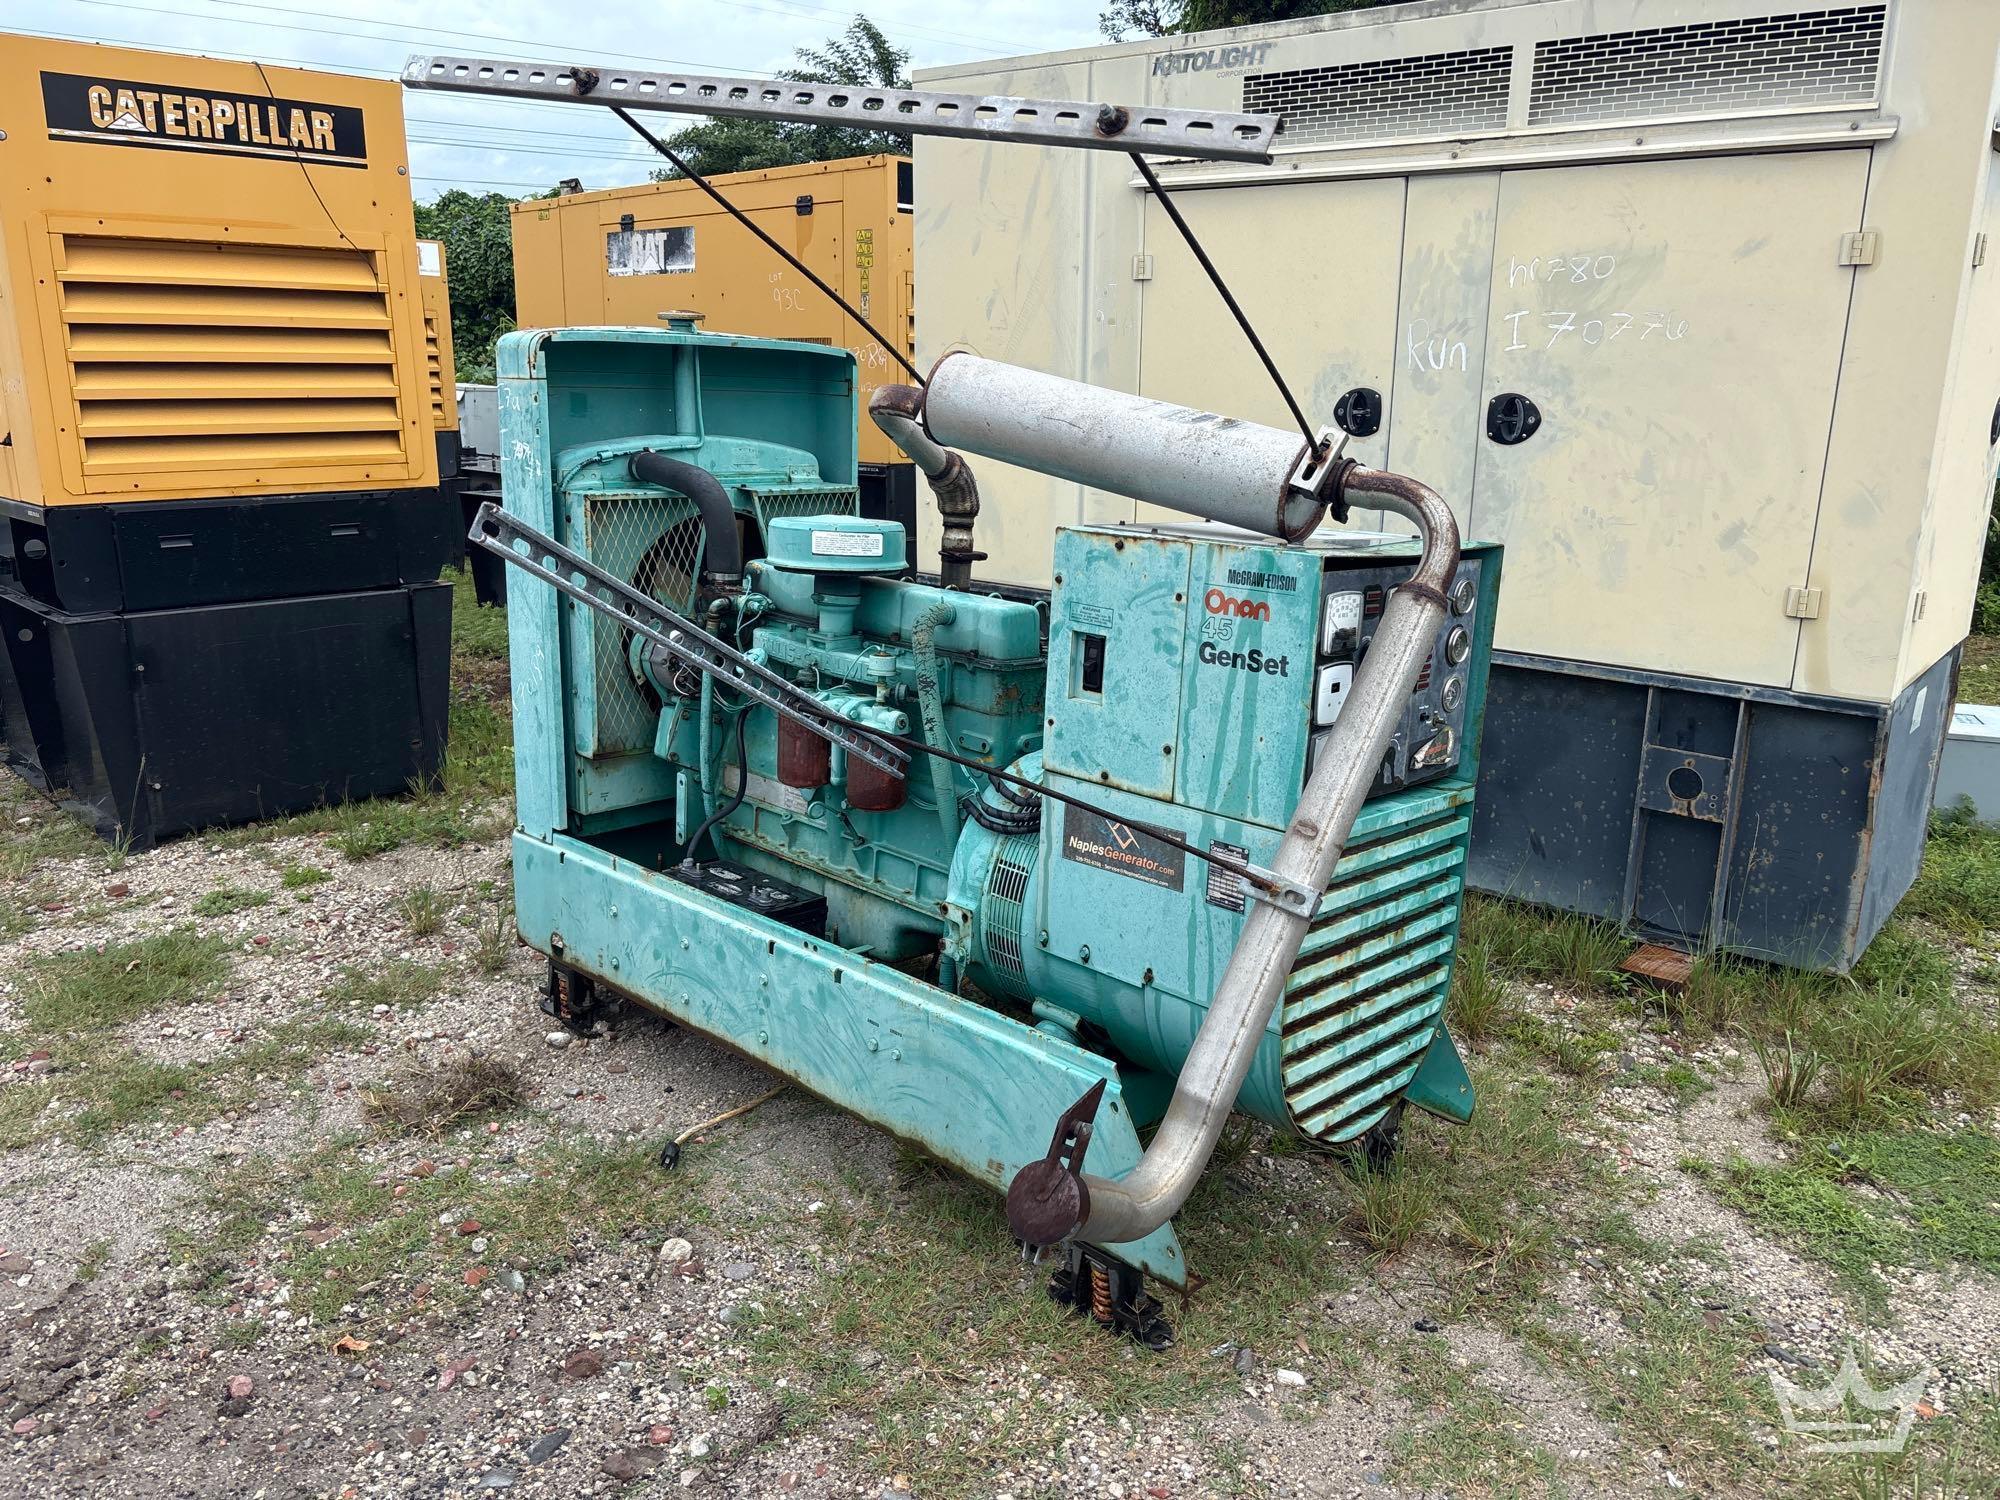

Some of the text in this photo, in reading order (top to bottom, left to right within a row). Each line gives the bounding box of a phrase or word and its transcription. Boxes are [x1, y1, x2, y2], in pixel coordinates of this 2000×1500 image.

[1152, 41, 1272, 77] KATOLIGHT
[1216, 67, 1263, 79] CORPORATION
[88, 85, 337, 151] CATERPILLAR
[773, 288, 806, 312] 93C
[1227, 568, 1298, 592] McGRAW-EDISON
[1204, 588, 1271, 622] Onan
[1200, 616, 1233, 641] 45
[1199, 641, 1290, 678] GenSet
[1068, 835, 1175, 876] NaplesGenerator.com
